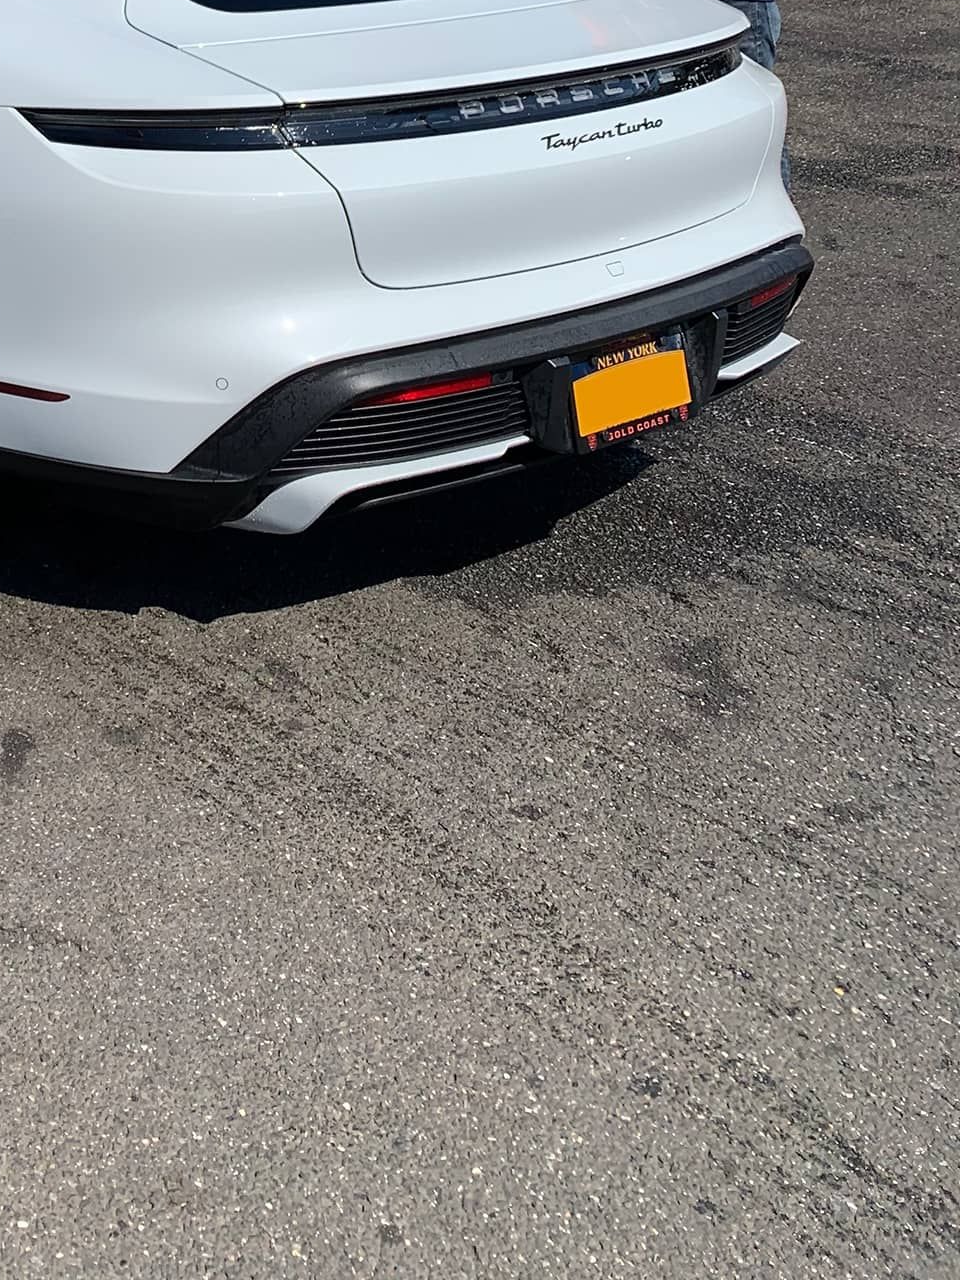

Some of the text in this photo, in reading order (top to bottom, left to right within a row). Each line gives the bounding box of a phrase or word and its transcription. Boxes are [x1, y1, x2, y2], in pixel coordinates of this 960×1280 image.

[457, 68, 676, 119] PORSCHE
[540, 117, 664, 152] Taycan turbo
[597, 340, 658, 370] NEW YORK
[636, 414, 670, 432] COAST
